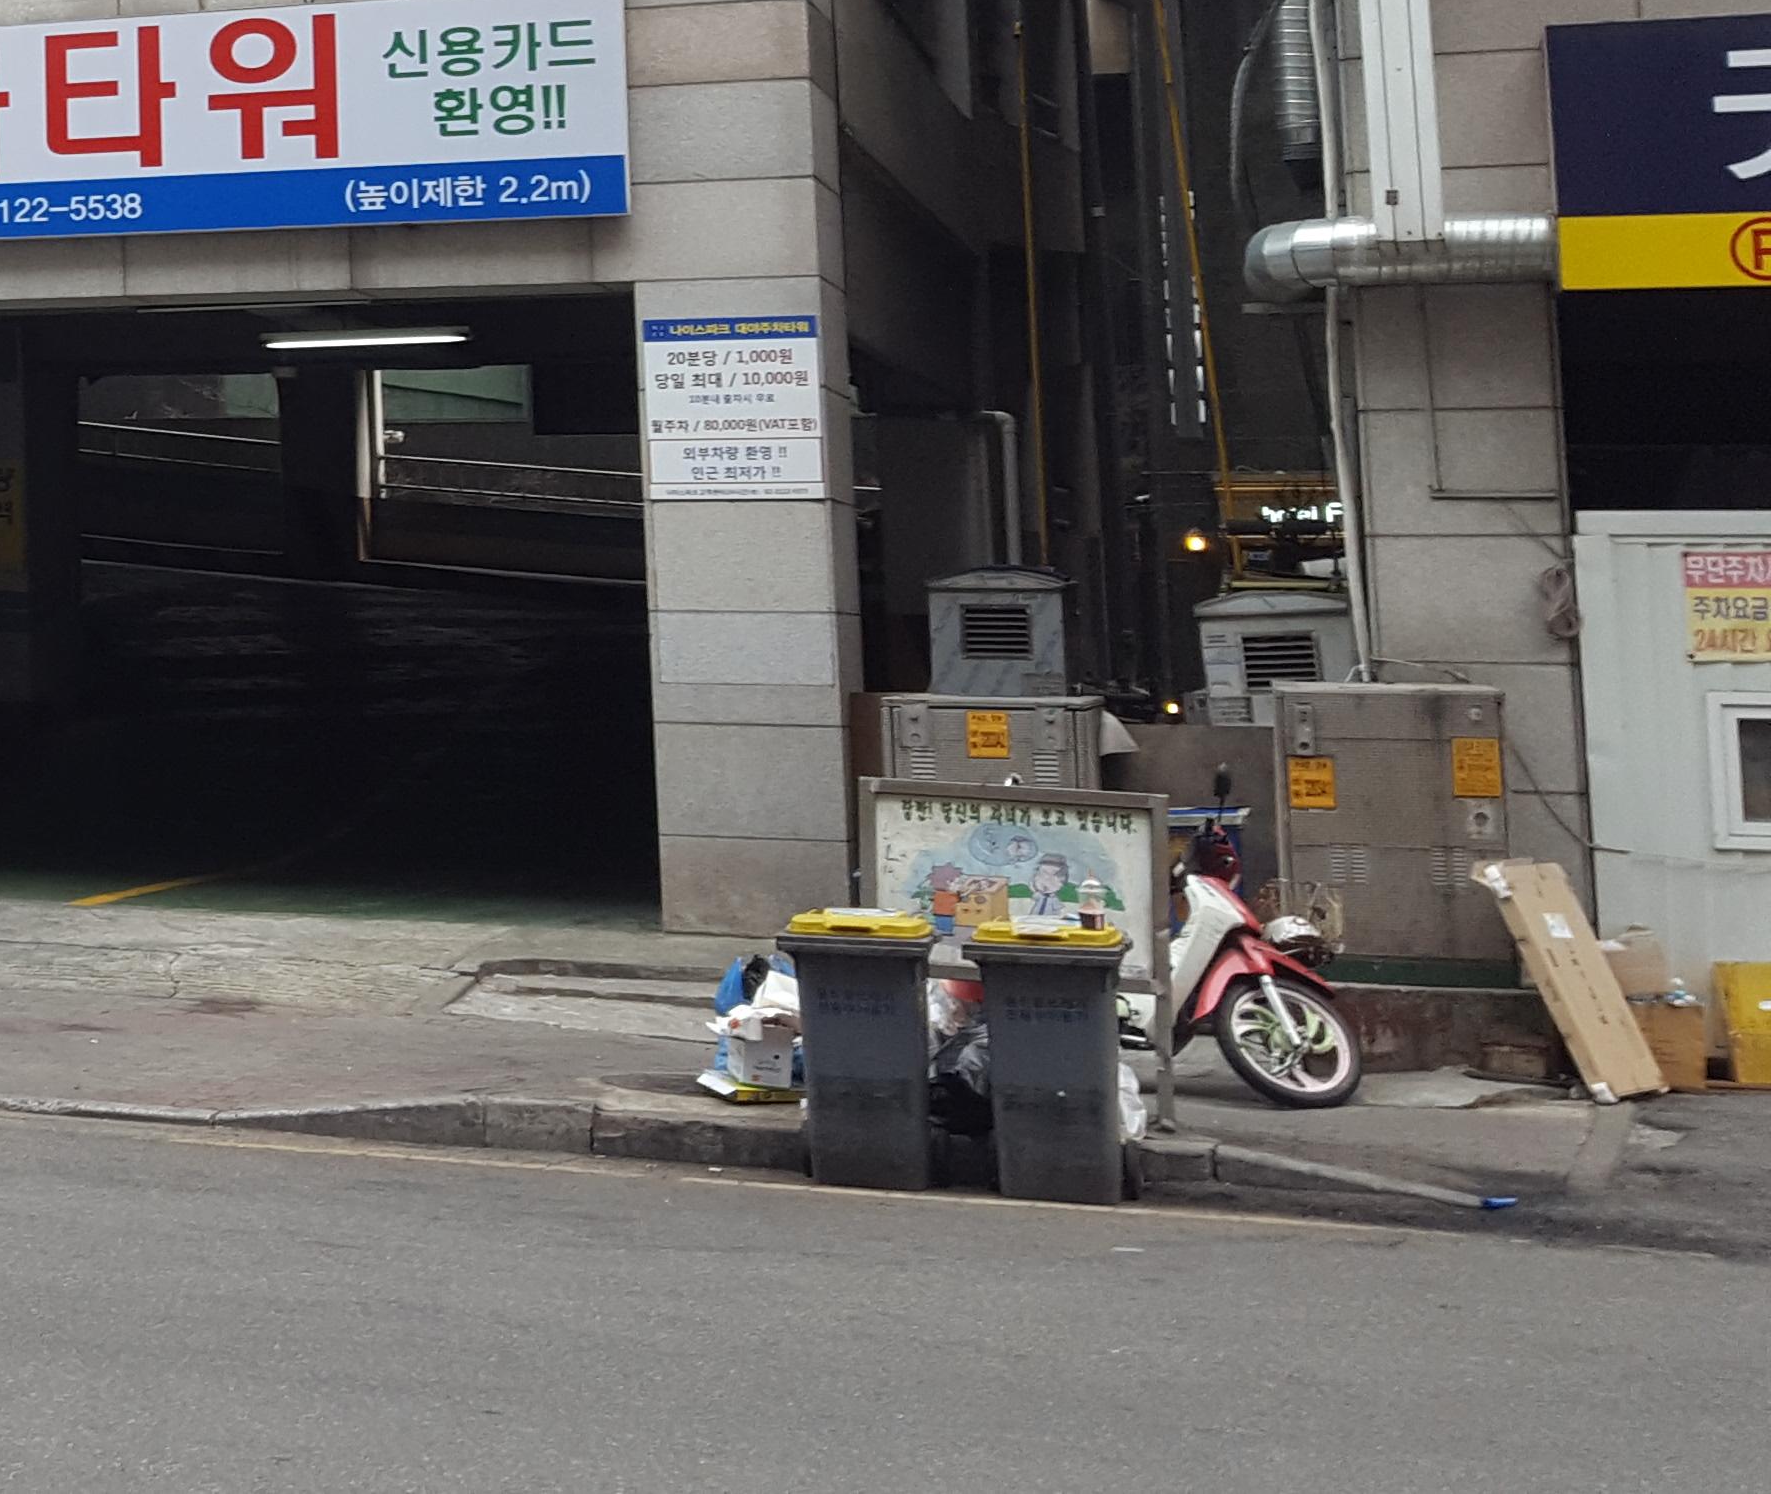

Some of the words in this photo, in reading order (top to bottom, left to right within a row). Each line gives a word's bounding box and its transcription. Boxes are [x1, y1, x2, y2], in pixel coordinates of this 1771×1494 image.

[382, 19, 597, 79] 신용카드
[432, 84, 567, 137] 환영!!
[344, 175, 488, 213] (높이제한
[498, 170, 593, 205] 2.2m)
[667, 350, 717, 367] 20분당
[736, 348, 793, 365] 1,000원
[655, 374, 685, 390] 당일
[692, 372, 723, 388] 최대
[743, 370, 809, 386] 10,000원
[651, 420, 689, 434] 월주차
[683, 446, 739, 461] 외부차량
[691, 466, 718, 480] 인근
[1686, 556, 1771, 583] 무단주차
[1693, 597, 1768, 620] 주차요금
